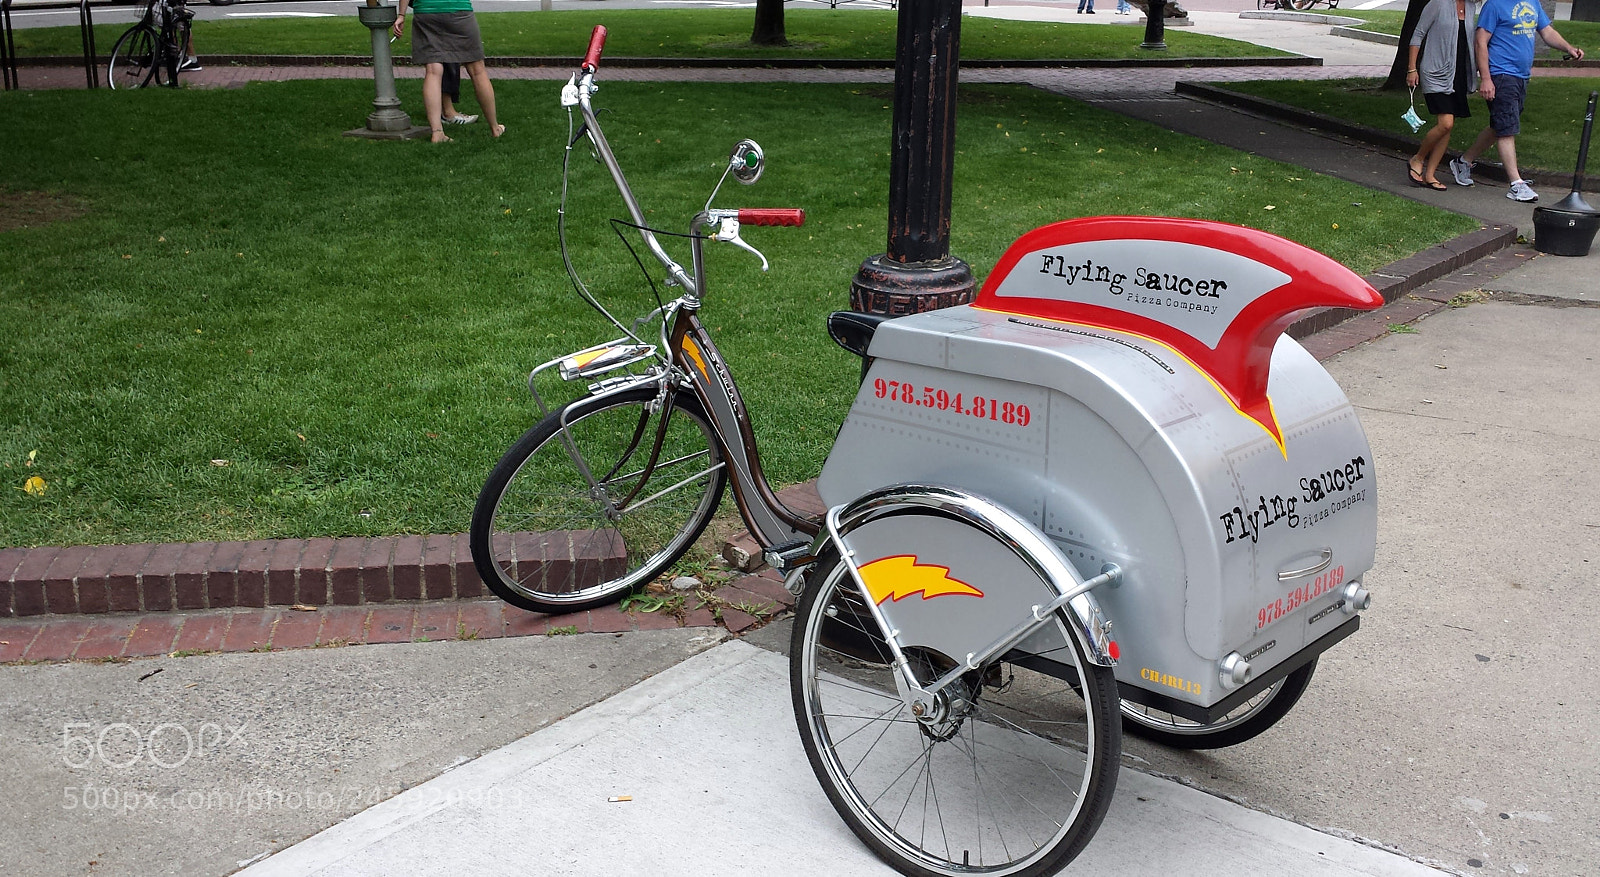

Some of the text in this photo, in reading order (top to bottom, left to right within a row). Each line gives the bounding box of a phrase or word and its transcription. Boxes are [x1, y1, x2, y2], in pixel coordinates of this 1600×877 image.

[1039, 254, 1228, 299] Flying Saucer
[1127, 292, 1218, 315] Pizza Company
[874, 378, 1031, 427] 978.594.8189
[1220, 455, 1365, 544] Flying Saucer
[1303, 489, 1366, 529] Pizza Company
[1258, 565, 1345, 629] 978.594.8189
